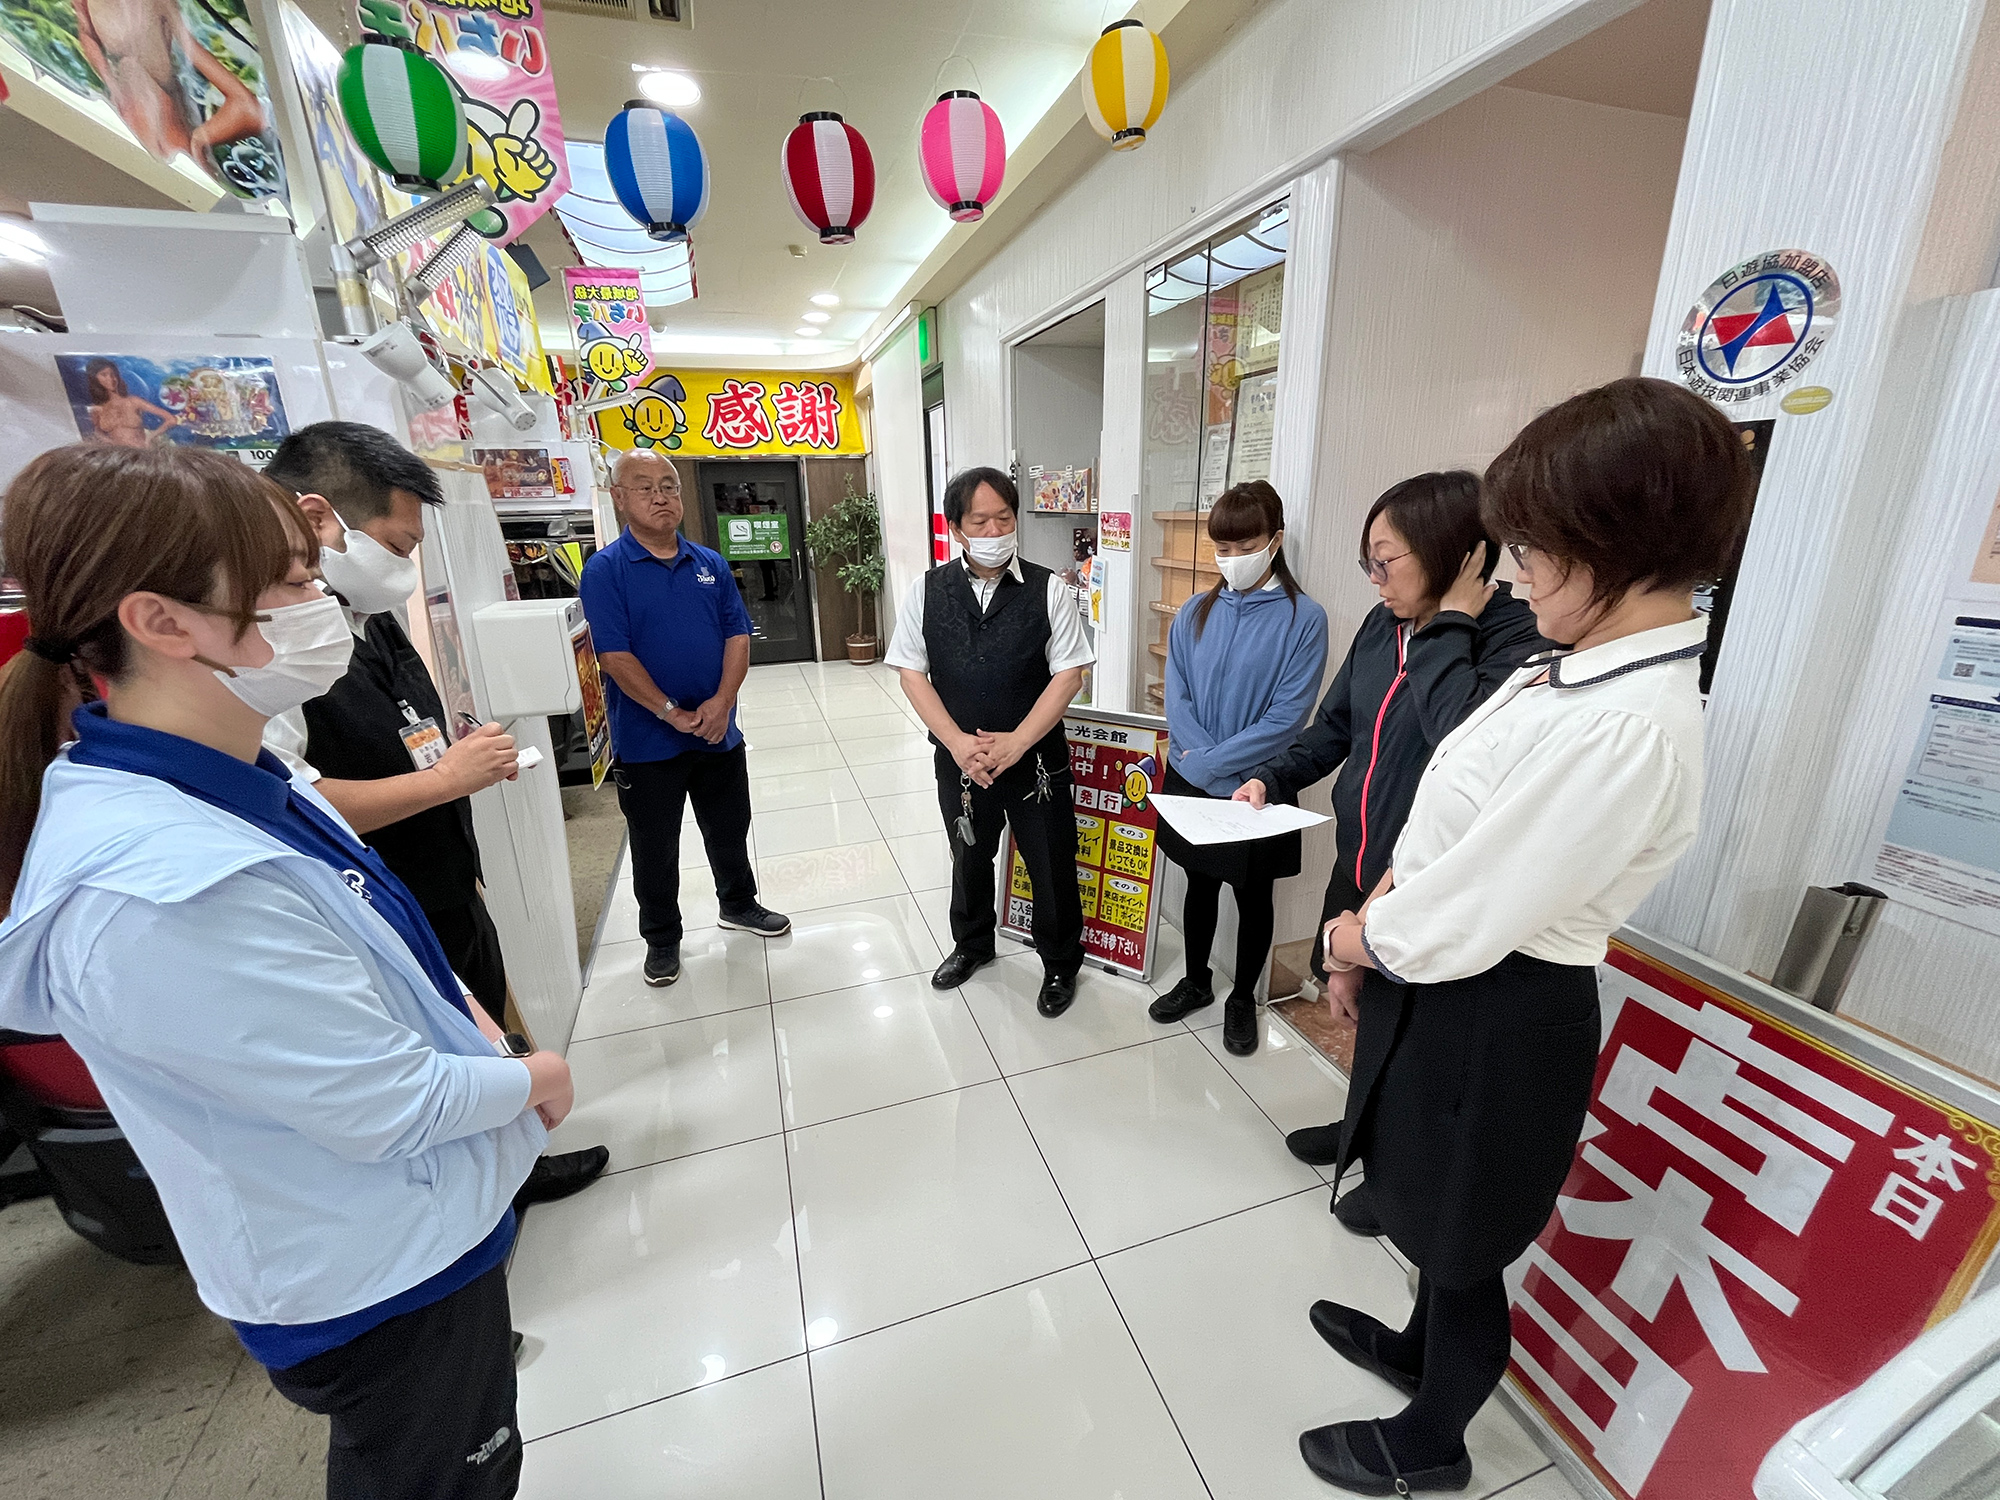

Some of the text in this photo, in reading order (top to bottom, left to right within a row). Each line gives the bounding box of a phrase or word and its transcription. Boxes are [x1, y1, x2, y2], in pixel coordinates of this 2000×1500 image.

[1721, 254, 1831, 289] 日遊協加盟店
[1679, 336, 1824, 402] 日本遊技関連事業協会
[702, 379, 842, 449] 感謝
[1109, 839, 1149, 858] 景品交換は
[1870, 1127, 1978, 1242] 本日
